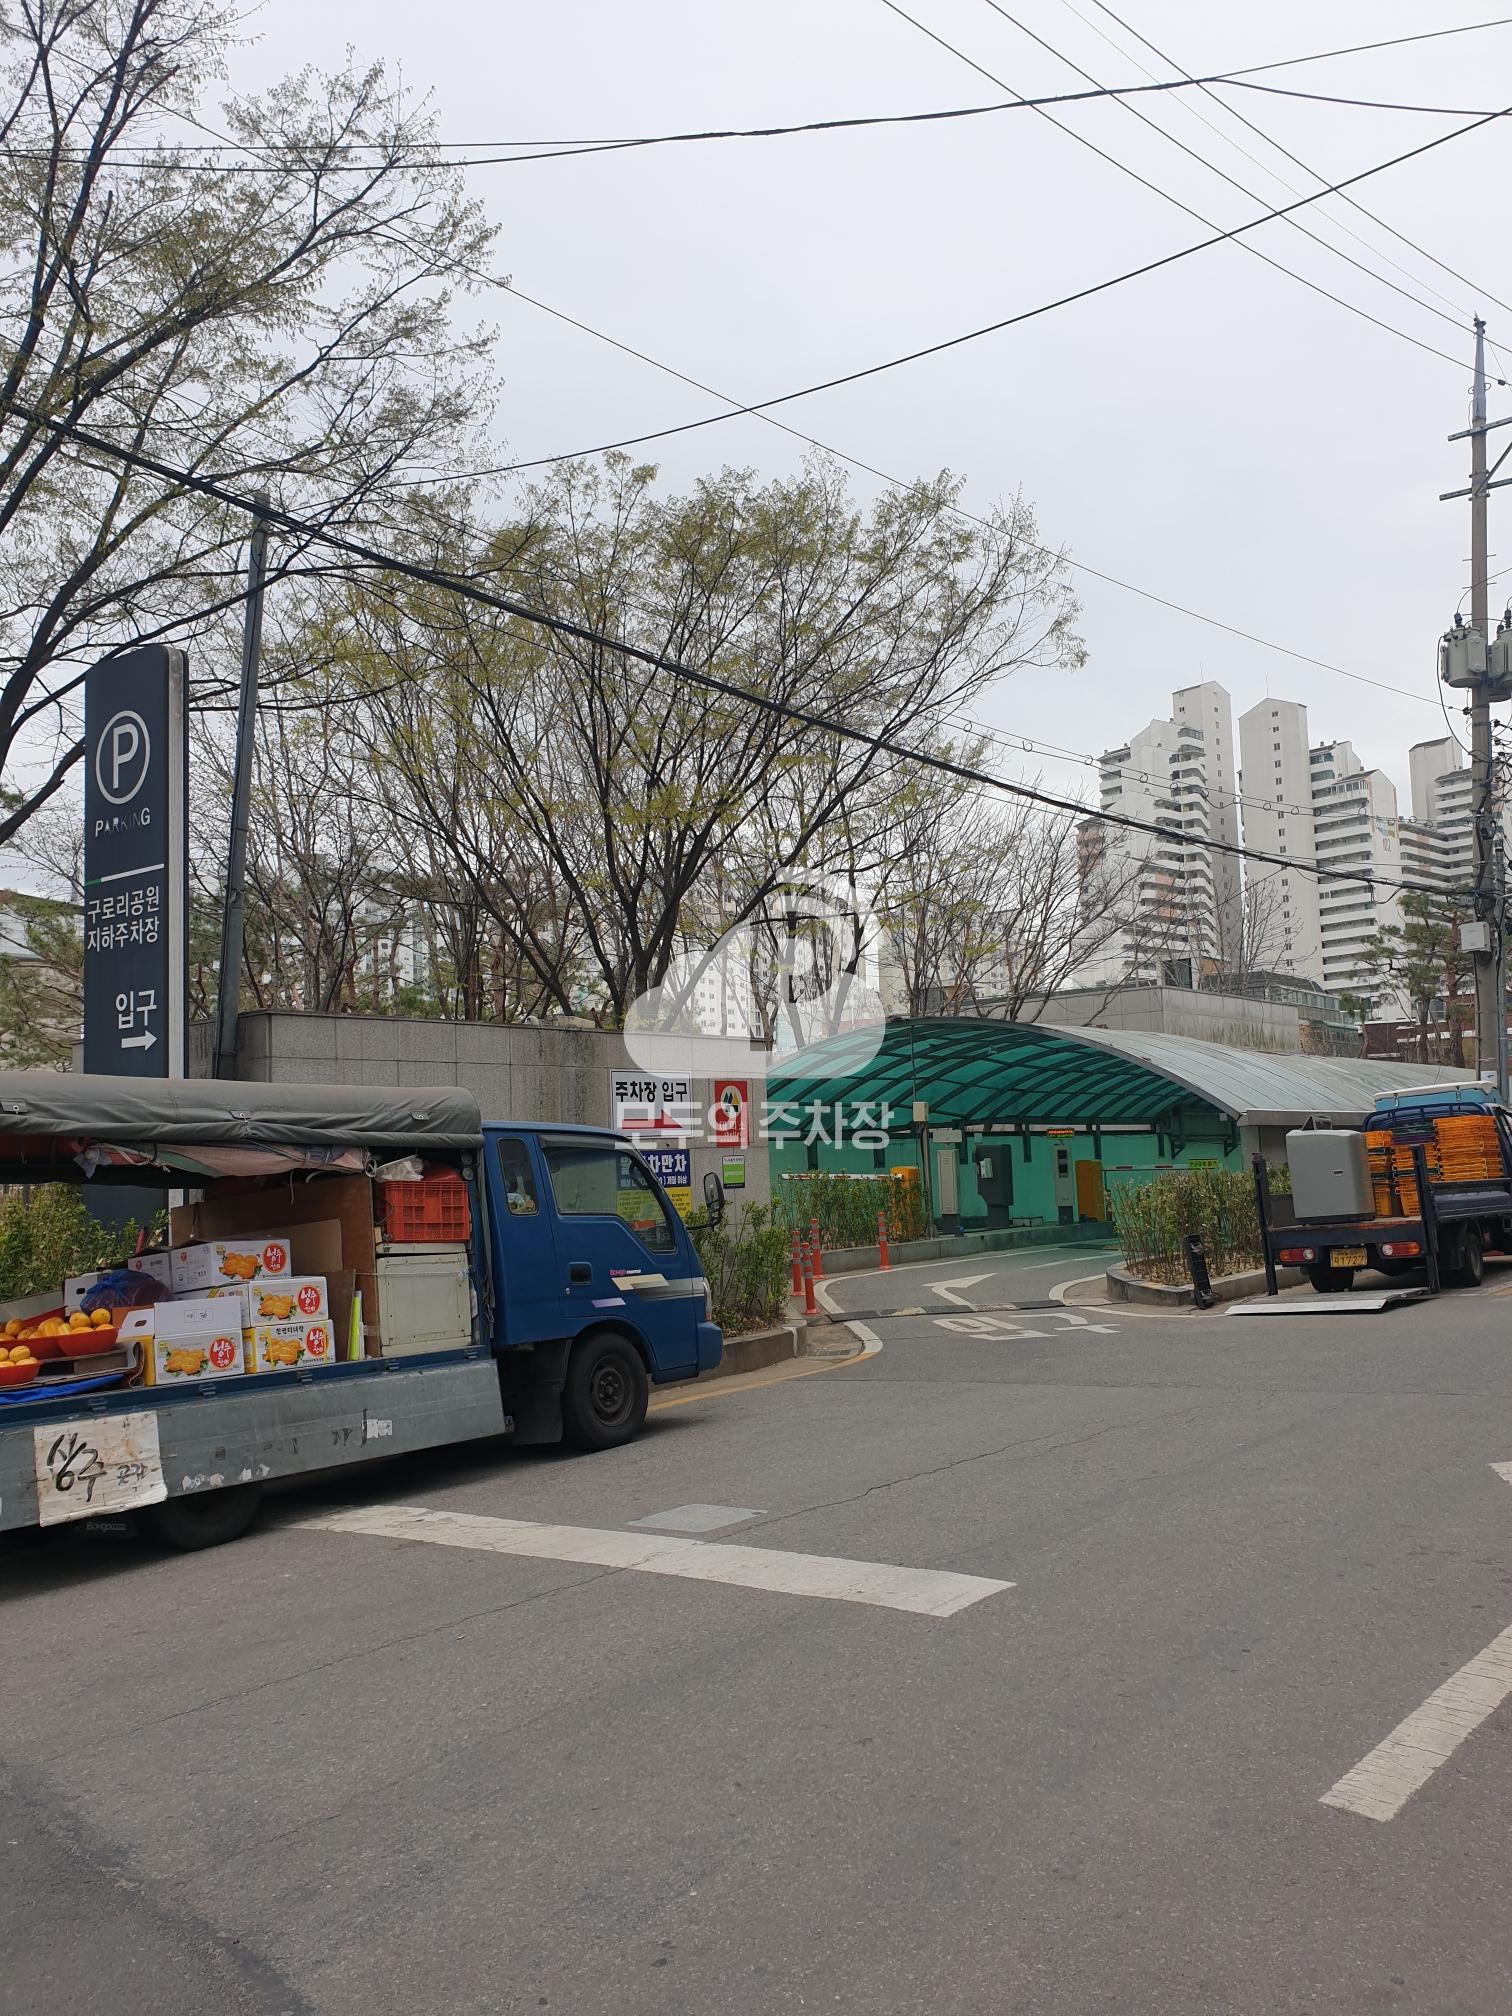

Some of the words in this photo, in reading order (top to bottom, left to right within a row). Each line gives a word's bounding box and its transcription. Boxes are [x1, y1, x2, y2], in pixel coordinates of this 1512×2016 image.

[112, 723, 139, 790] P
[95, 807, 151, 838] PARKING
[87, 885, 159, 924] 구로리공원
[87, 915, 160, 953] 지하주차장
[115, 989, 157, 1030] 입구
[615, 1081, 657, 1102] 주차장
[661, 1081, 688, 1102] 입구
